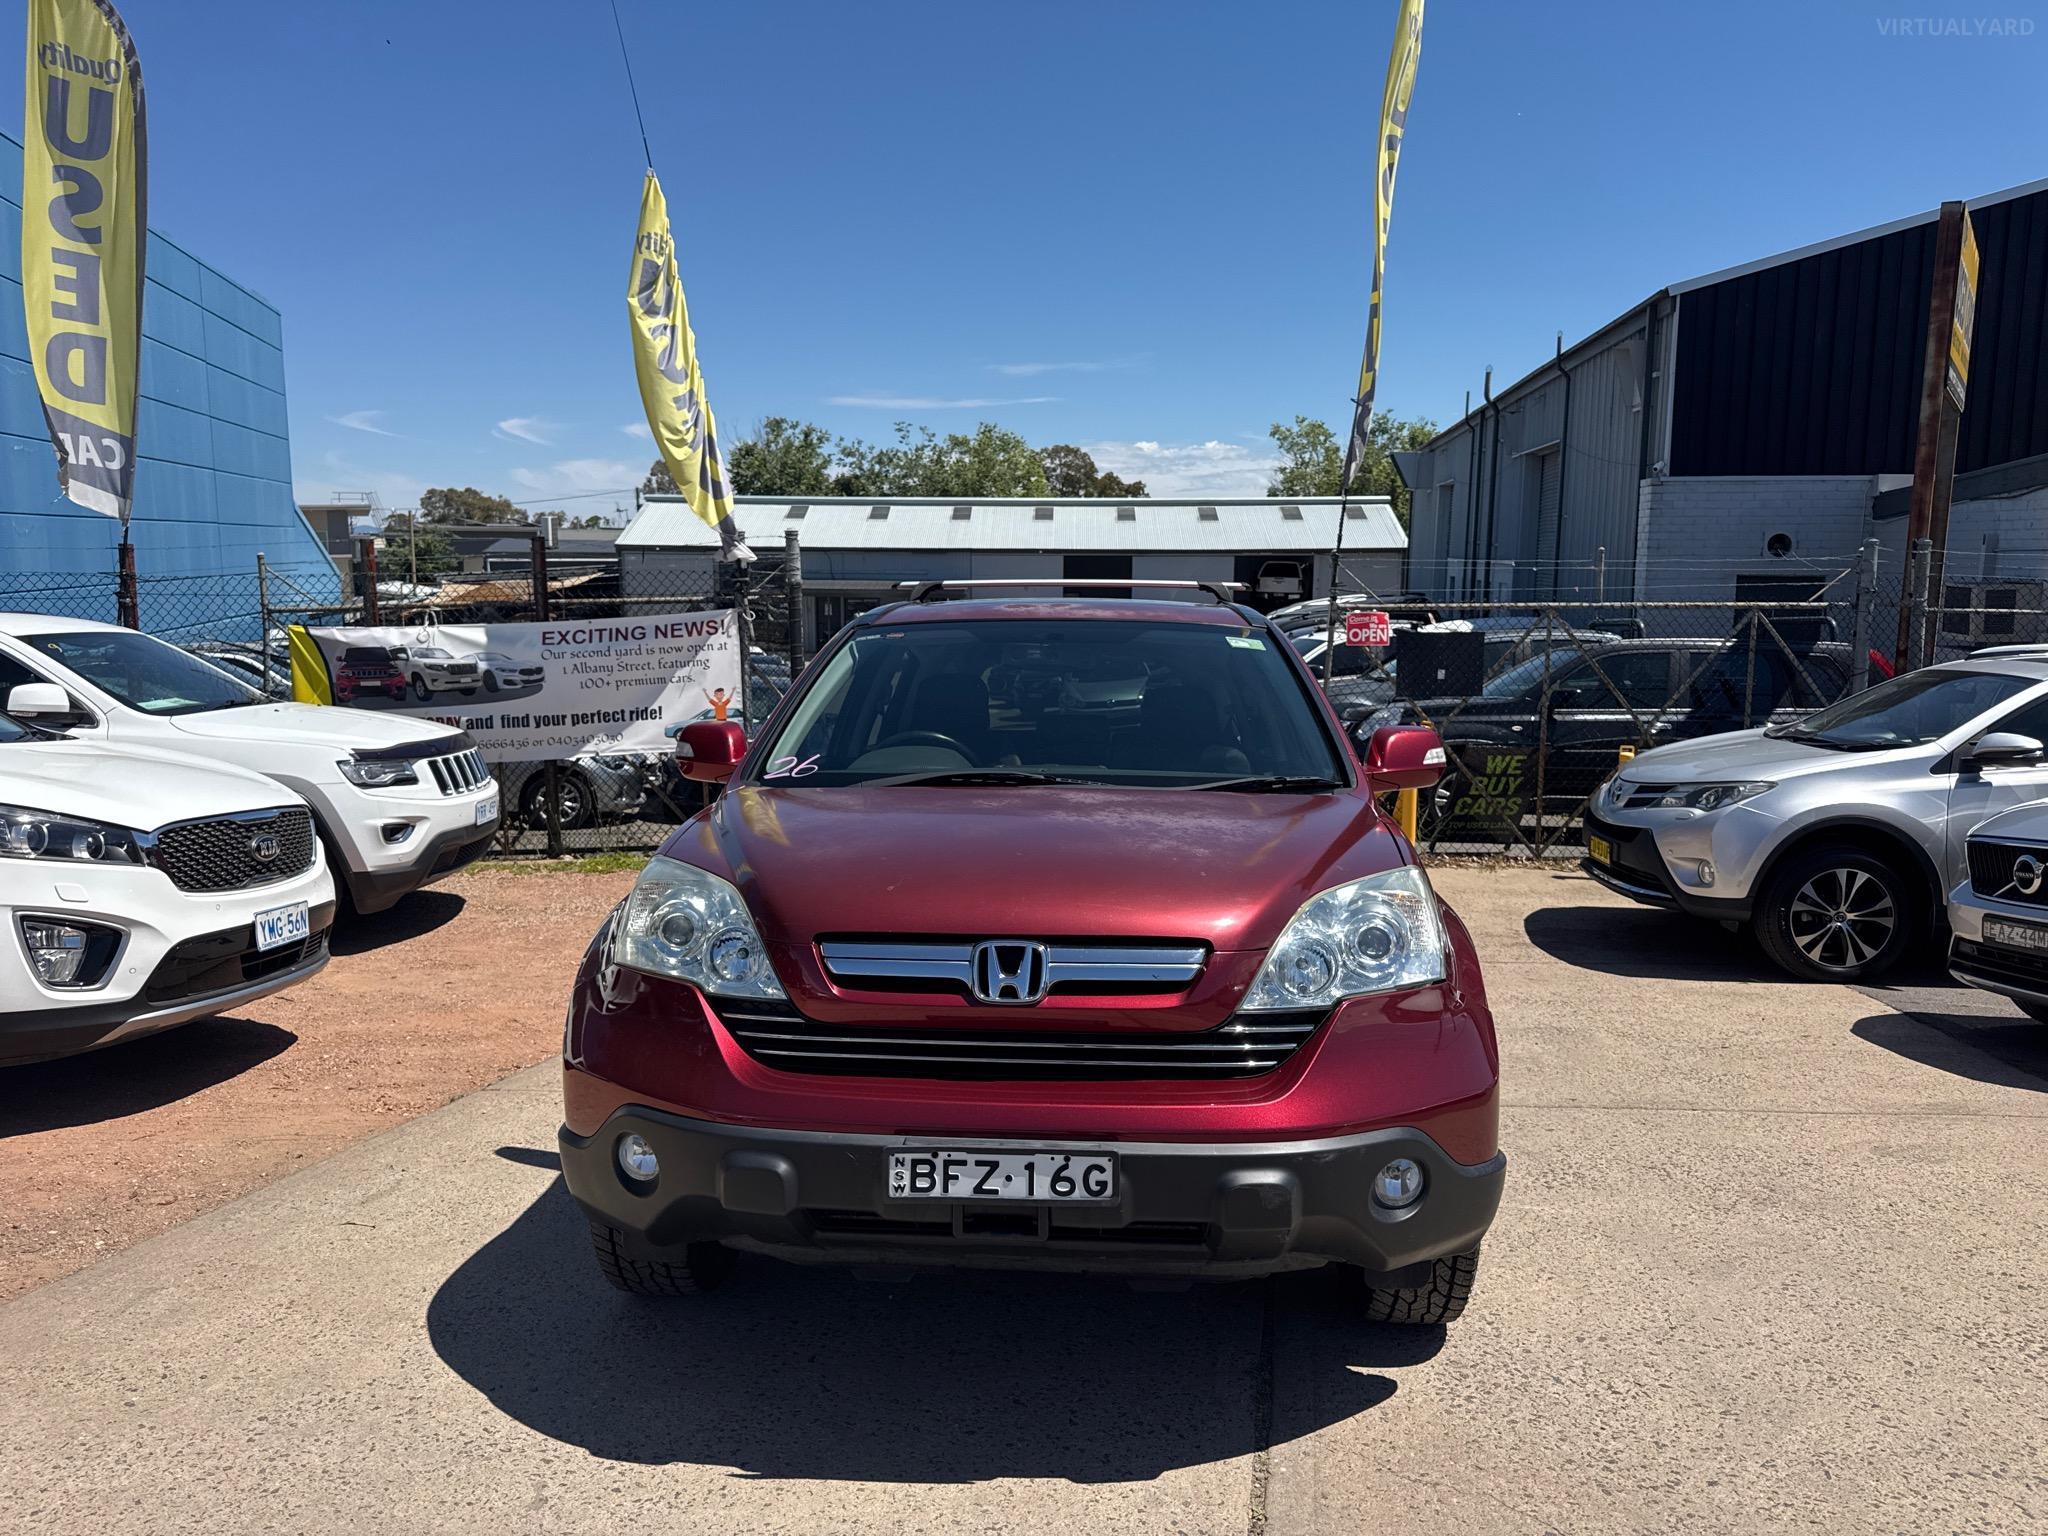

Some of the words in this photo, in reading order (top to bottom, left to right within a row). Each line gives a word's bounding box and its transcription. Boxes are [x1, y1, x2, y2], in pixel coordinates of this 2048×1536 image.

[1349, 615, 1370, 623] Come
[541, 625, 647, 646] EXCITING
[654, 619, 727, 639] NEWS!
[1349, 628, 1388, 642] OPEN
[541, 648, 566, 661] Our
[570, 645, 611, 660] second
[615, 644, 642, 661] yard
[646, 643, 656, 656] is
[658, 644, 684, 655] now
[687, 642, 714, 656] open
[717, 640, 728, 651] at
[562, 666, 568, 675] 1
[570, 661, 614, 677] Albany
[658, 655, 711, 670] featuring
[579, 677, 612, 690] 100+
[615, 674, 667, 691] premium
[669, 673, 696, 684] cars.
[466, 714, 494, 731] and
[501, 713, 530, 730] find
[534, 714, 568, 730] your
[571, 708, 627, 727] perfect
[629, 706, 664, 722] ride!
[533, 737, 545, 747] or
[763, 754, 821, 780] 26
[1486, 754, 1528, 775] WE
[1469, 776, 1525, 796] BUY
[1454, 796, 1522, 816] CARS
[260, 839, 279, 856] KIA
